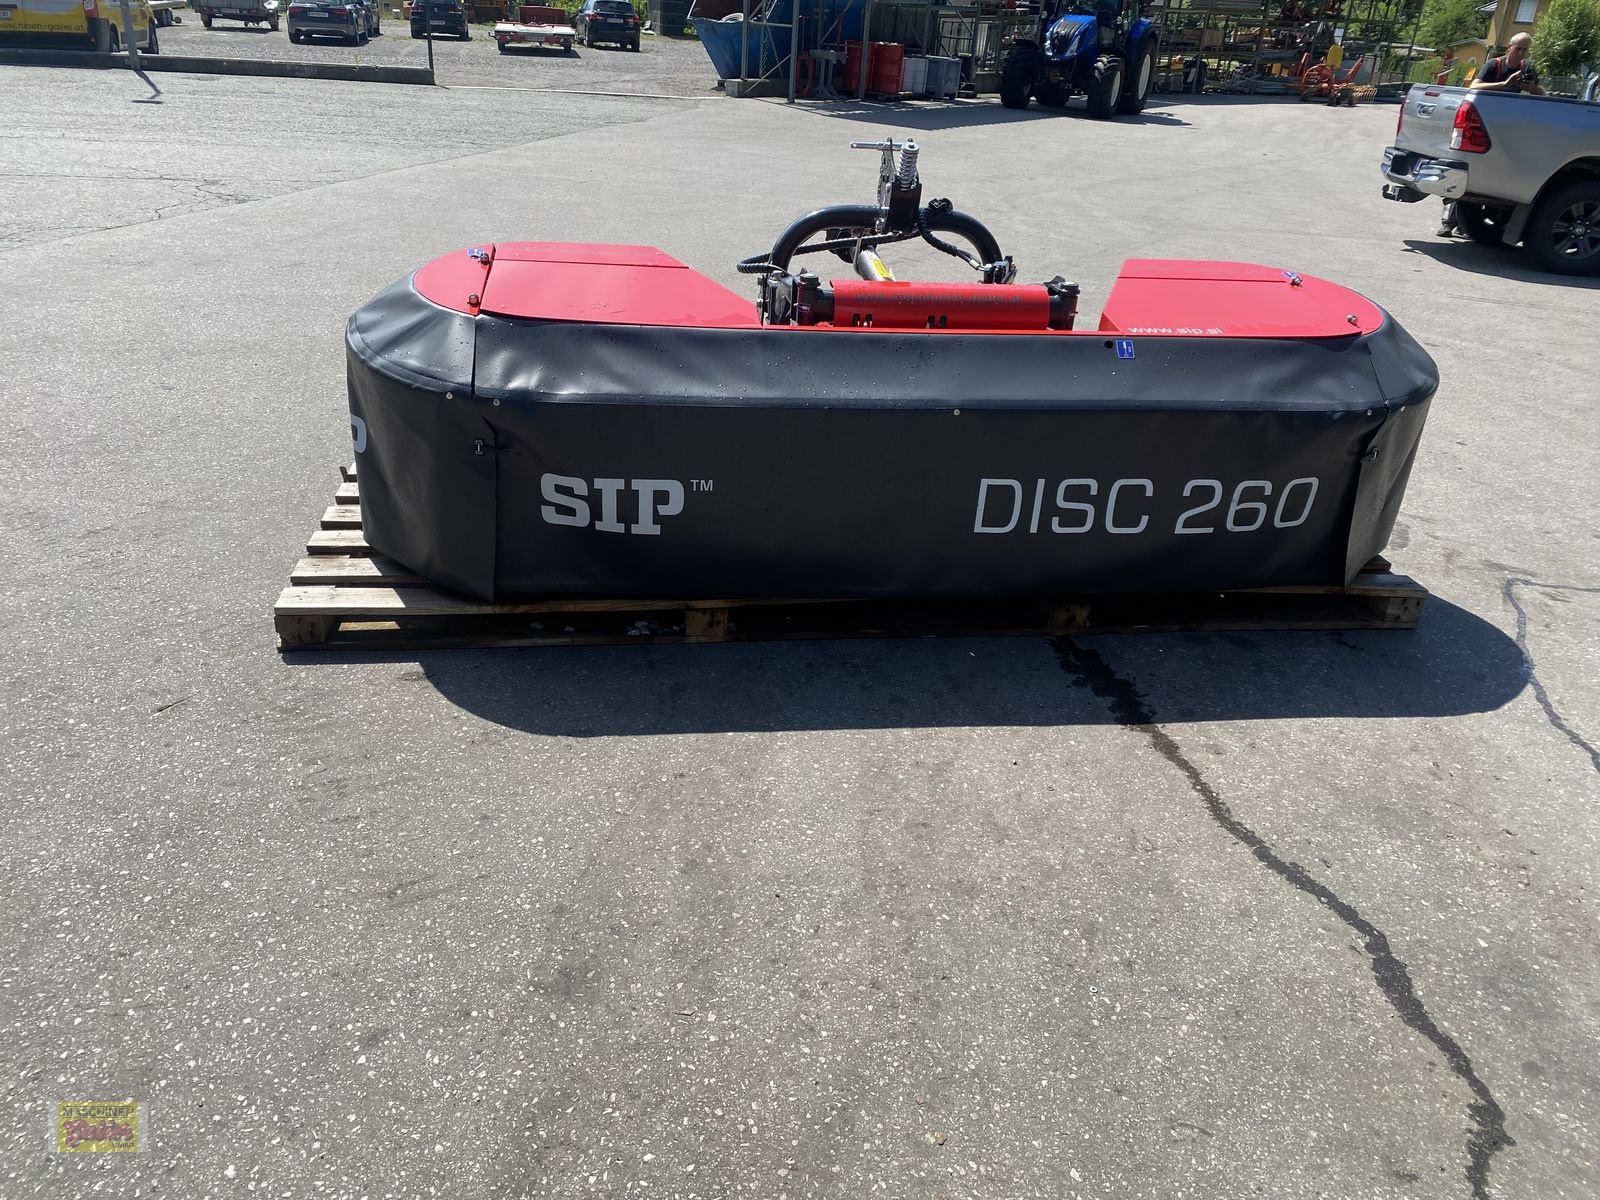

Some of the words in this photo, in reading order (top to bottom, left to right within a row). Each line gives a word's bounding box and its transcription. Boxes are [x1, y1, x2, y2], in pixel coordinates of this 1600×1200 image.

[0, 22, 84, 32] aschinen-gailer.at
[1128, 327, 1224, 335] www.sip.si
[540, 472, 685, 536] SIP
[974, 478, 1154, 534] DISC
[1174, 477, 1320, 535] 260
